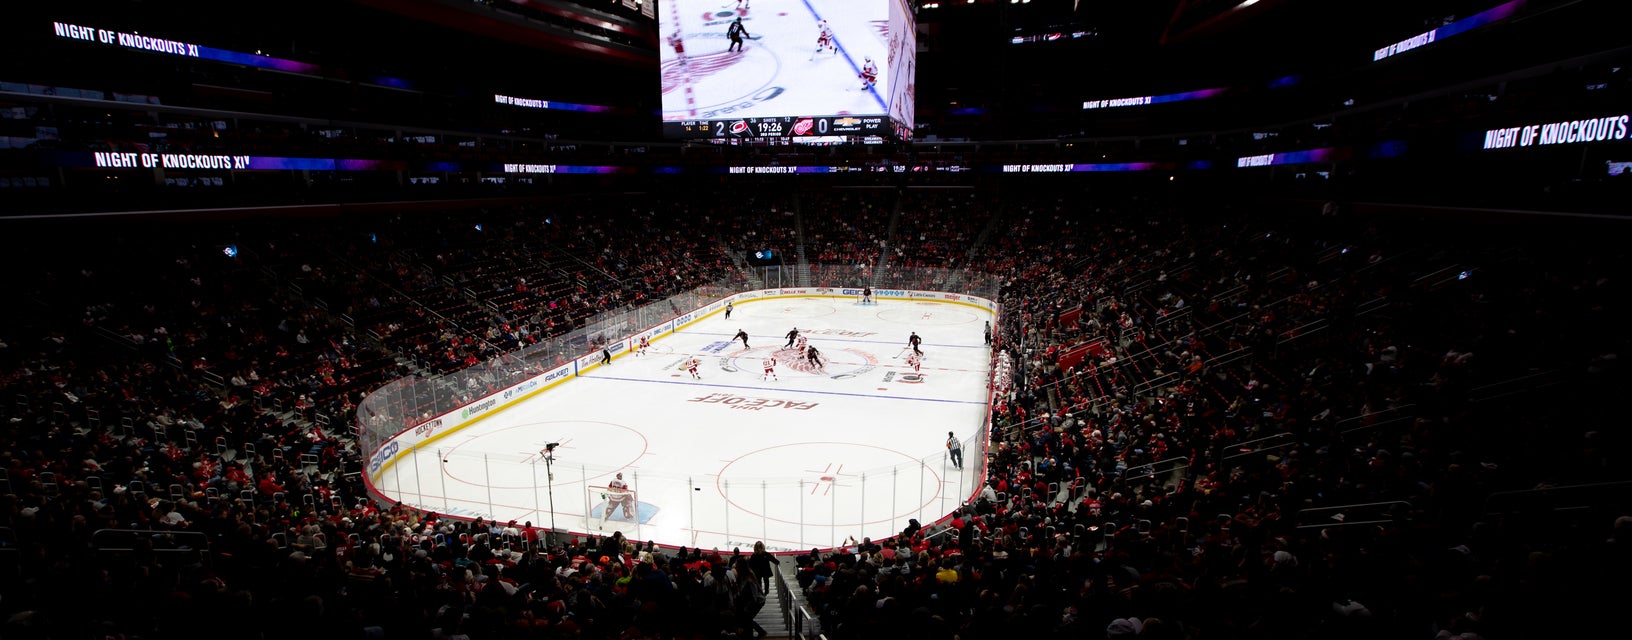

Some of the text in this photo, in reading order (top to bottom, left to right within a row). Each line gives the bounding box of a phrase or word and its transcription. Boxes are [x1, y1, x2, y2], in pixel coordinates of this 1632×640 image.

[54, 22, 95, 42] NIGHT
[98, 29, 115, 44] OF
[117, 32, 186, 56] KNOCKOUTS
[495, 94, 508, 104] NIGHT
[508, 96, 514, 105] OF
[514, 97, 542, 108] KNOCKOUTS
[1083, 100, 1100, 109] NIGHT
[1101, 99, 1109, 108] OF
[1109, 97, 1144, 107] KNOCKOUTS
[716, 121, 725, 136] 2
[757, 122, 782, 132] 19:26
[818, 118, 828, 134] 0
[1484, 127, 1521, 149] NIGHT
[1520, 125, 1540, 147] OF
[1539, 115, 1629, 145] KNOCKOUTS
[94, 151, 138, 168] NIGHT
[141, 153, 159, 168] OF
[161, 153, 232, 169] KNOCKOUTS
[504, 164, 518, 173] NIGHT
[519, 164, 525, 173] OF
[526, 164, 549, 173] KNOCKOUTS
[729, 166, 746, 174] NIGHT
[747, 166, 754, 174] OF
[755, 166, 787, 174] KNOCKOUTS
[1003, 164, 1021, 172] NIGHT
[1022, 164, 1031, 172] OF
[1031, 164, 1063, 172] KNOCKOUTS
[842, 289, 864, 297] GEIC
[944, 294, 961, 302] meijer
[545, 367, 569, 382] FALKEN
[468, 398, 496, 416] Huntington
[415, 419, 443, 436] HOCKEYTOWN
[371, 441, 399, 472] GEICO
